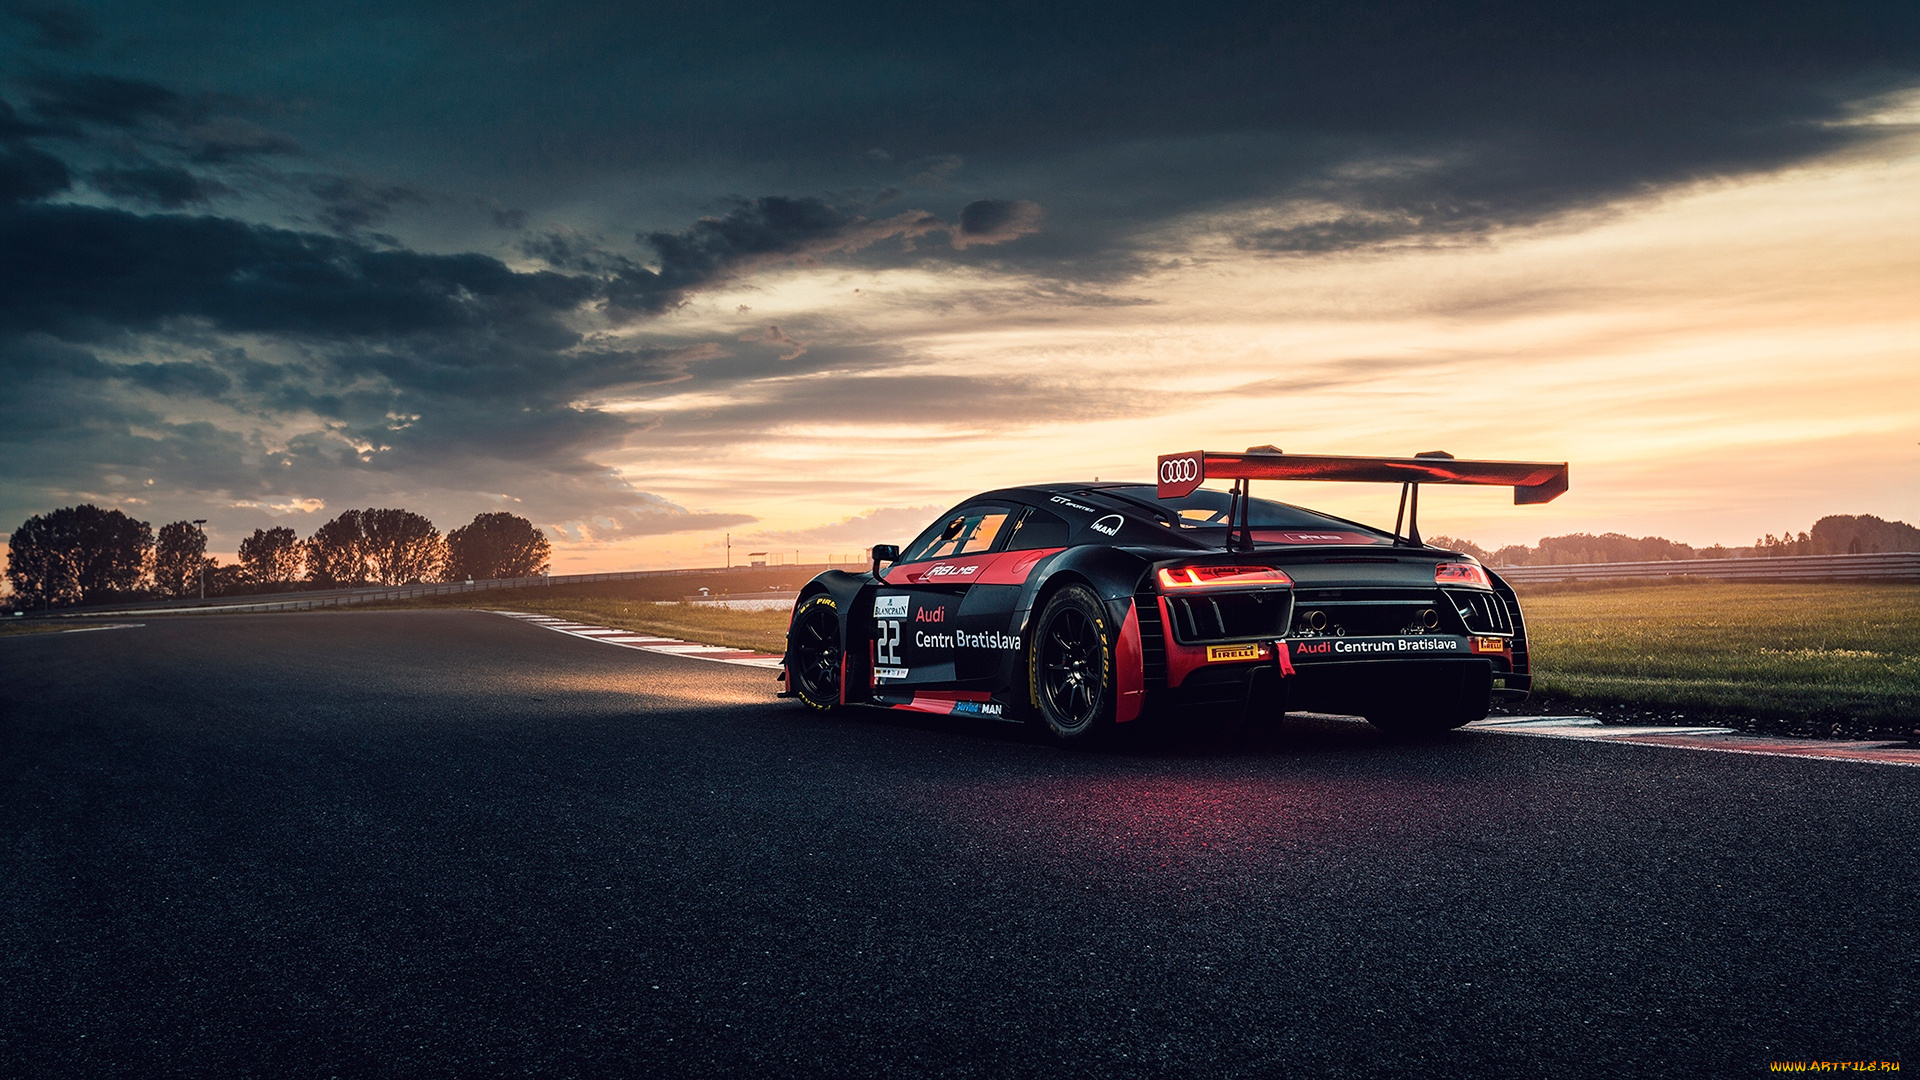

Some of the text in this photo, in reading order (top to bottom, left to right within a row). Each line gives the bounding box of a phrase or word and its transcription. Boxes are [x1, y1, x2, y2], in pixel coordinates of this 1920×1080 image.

[1093, 523, 1117, 536] MAN
[816, 598, 837, 609] PIRE
[875, 605, 907, 616] BLANCPAIN
[915, 606, 945, 623] Audi
[877, 620, 902, 665] 22
[956, 629, 1021, 650] Bratislava
[1296, 638, 1458, 654] Audi Centrum Bratislava
[1211, 644, 1255, 659] PIRELLI
[981, 703, 1003, 715] MAN
